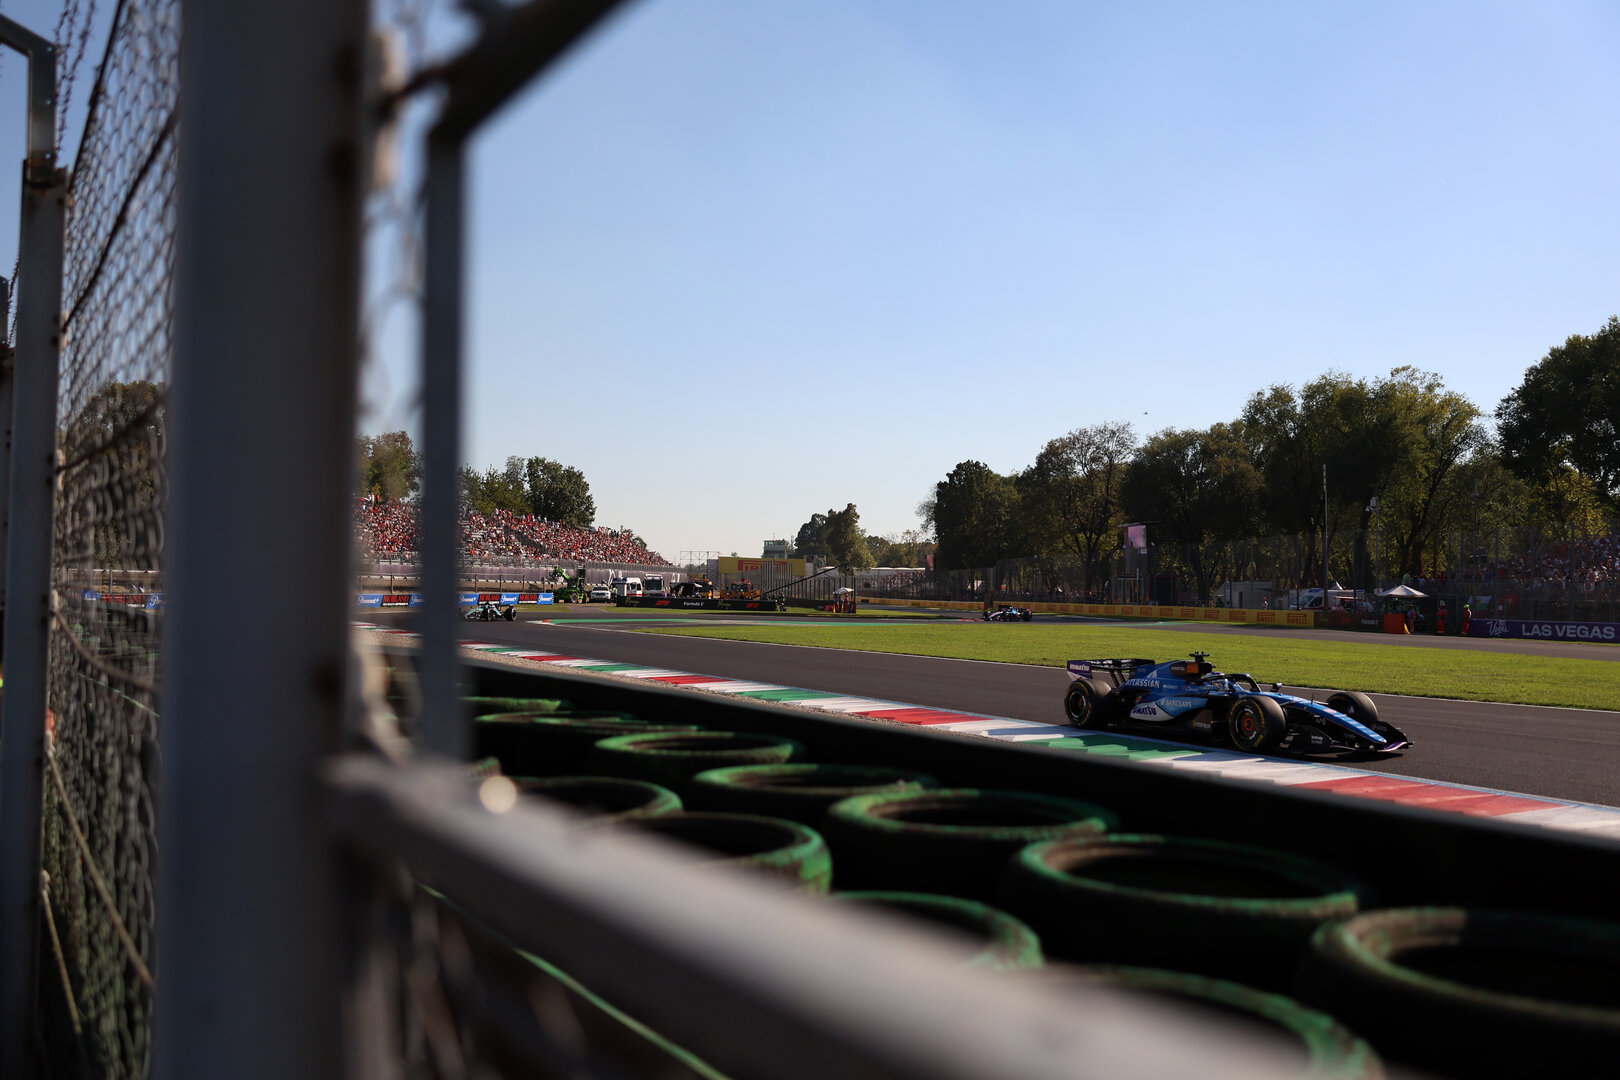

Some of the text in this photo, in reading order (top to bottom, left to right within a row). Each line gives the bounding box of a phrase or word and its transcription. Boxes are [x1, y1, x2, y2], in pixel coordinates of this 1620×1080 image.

[1522, 623, 1616, 639] LAS VEGAS
[1125, 679, 1160, 688] ATLASSIAN
[1166, 699, 1192, 708] BARCLAYS
